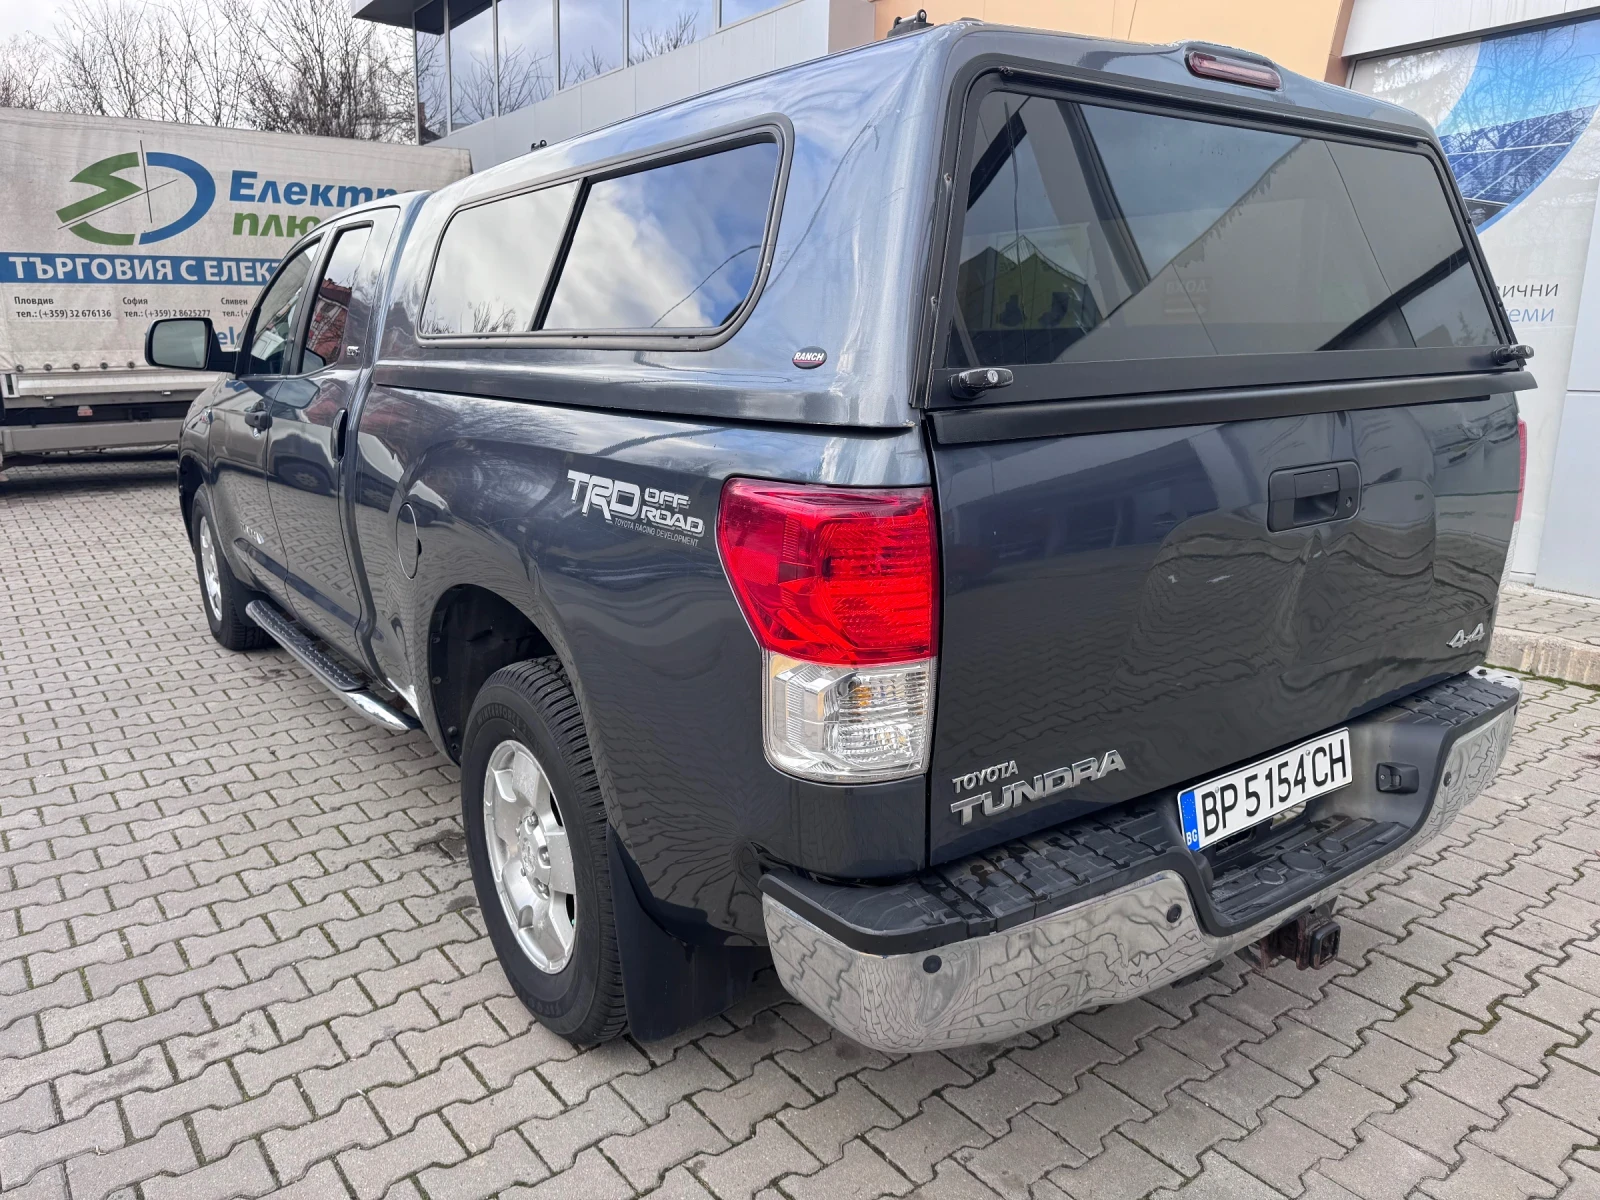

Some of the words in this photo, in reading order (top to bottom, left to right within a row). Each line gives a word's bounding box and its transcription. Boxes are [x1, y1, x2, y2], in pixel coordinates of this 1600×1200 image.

[8, 256, 173, 281] ТЪРГОВИЯ
[180, 260, 198, 281] С
[14, 296, 54, 306] Пловдив
[122, 297, 148, 306] София
[220, 297, 248, 306] Сливен
[16, 310, 38, 318] тел.:
[38, 309, 68, 319] (+359)
[69, 309, 80, 318] 32
[81, 309, 112, 318] 676136
[144, 309, 171, 318] (+359)
[1505, 308, 1555, 322] еми
[793, 352, 825, 361] RANCH
[567, 469, 641, 524] TRD
[643, 487, 691, 511] OFF
[640, 505, 705, 537] ROAD
[614, 517, 634, 530] TOYOTA
[634, 523, 656, 536] RACING
[656, 528, 699, 547] DEVELOPMENT
[951, 760, 1019, 793] TOYOTA
[1244, 753, 1307, 817] 5154
[1311, 738, 1347, 788] CH
[950, 749, 1127, 826] TUNDRA
[1185, 829, 1198, 846] BG
